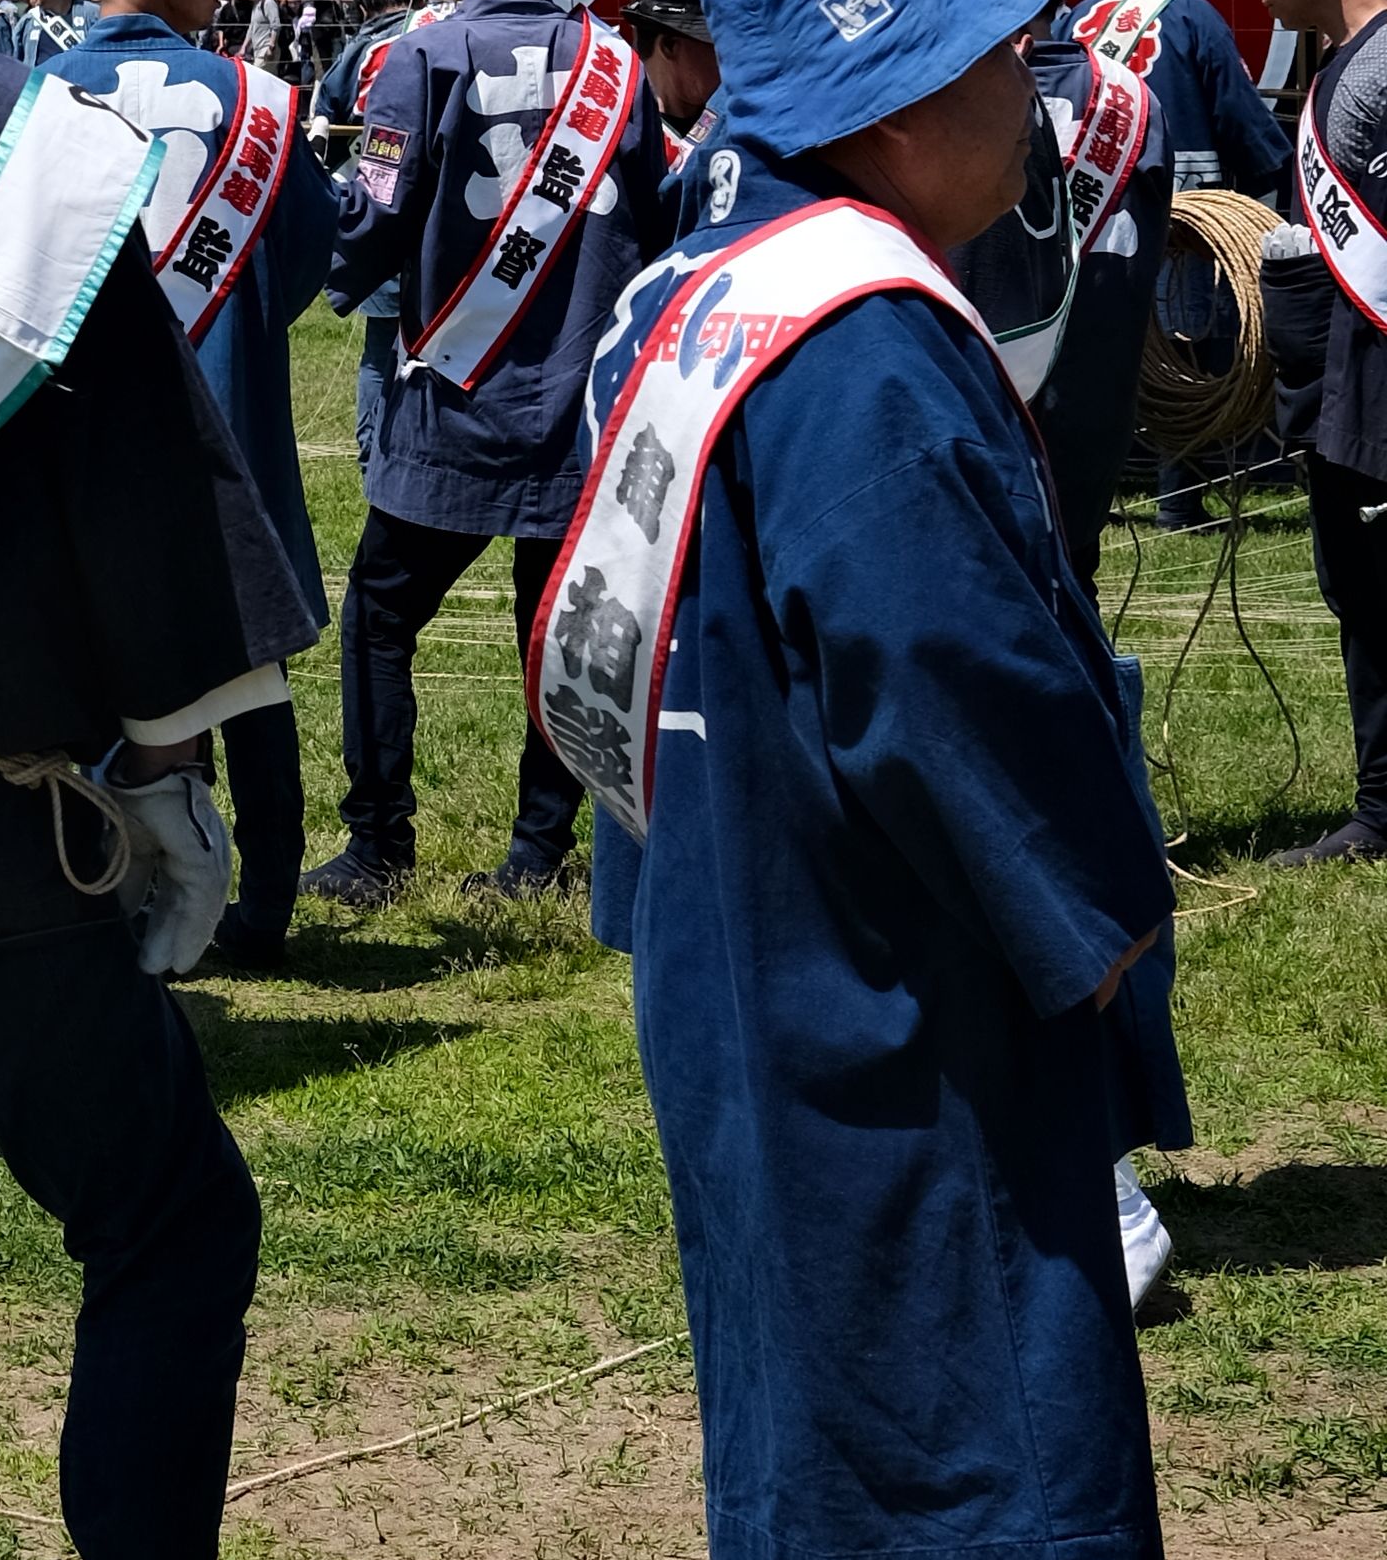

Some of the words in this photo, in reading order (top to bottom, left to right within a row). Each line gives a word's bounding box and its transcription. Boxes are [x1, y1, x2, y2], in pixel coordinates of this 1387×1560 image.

[565, 41, 624, 144] 立野連
[1084, 81, 1136, 177] 立野連
[219, 105, 282, 217] 立野連
[490, 142, 586, 294] 監督
